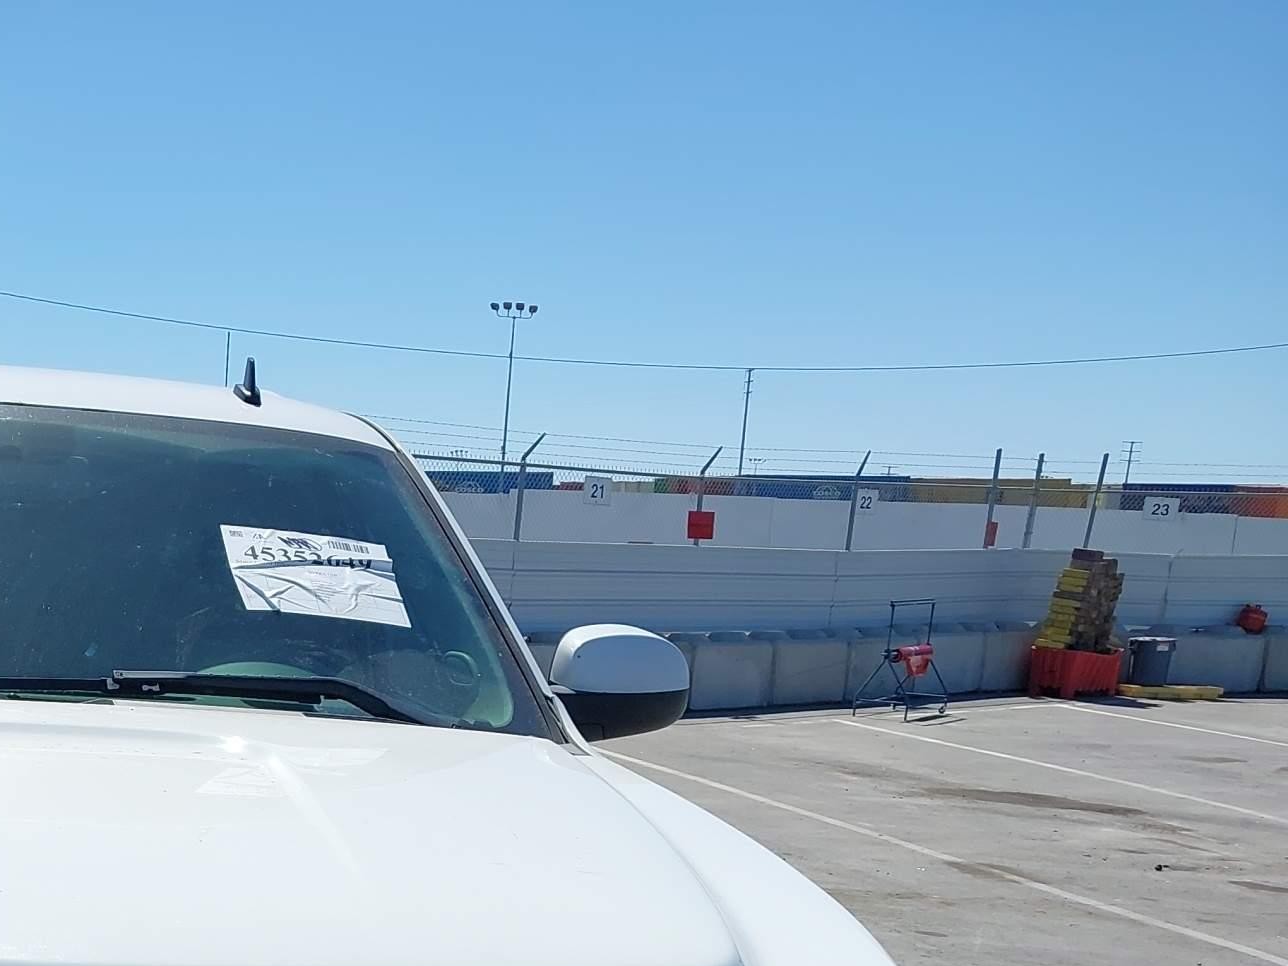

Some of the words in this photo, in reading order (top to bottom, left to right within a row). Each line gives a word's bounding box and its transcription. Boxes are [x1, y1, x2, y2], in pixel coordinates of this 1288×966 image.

[590, 483, 606, 499] 21
[859, 496, 873, 510] 22
[1151, 503, 1170, 516] 23
